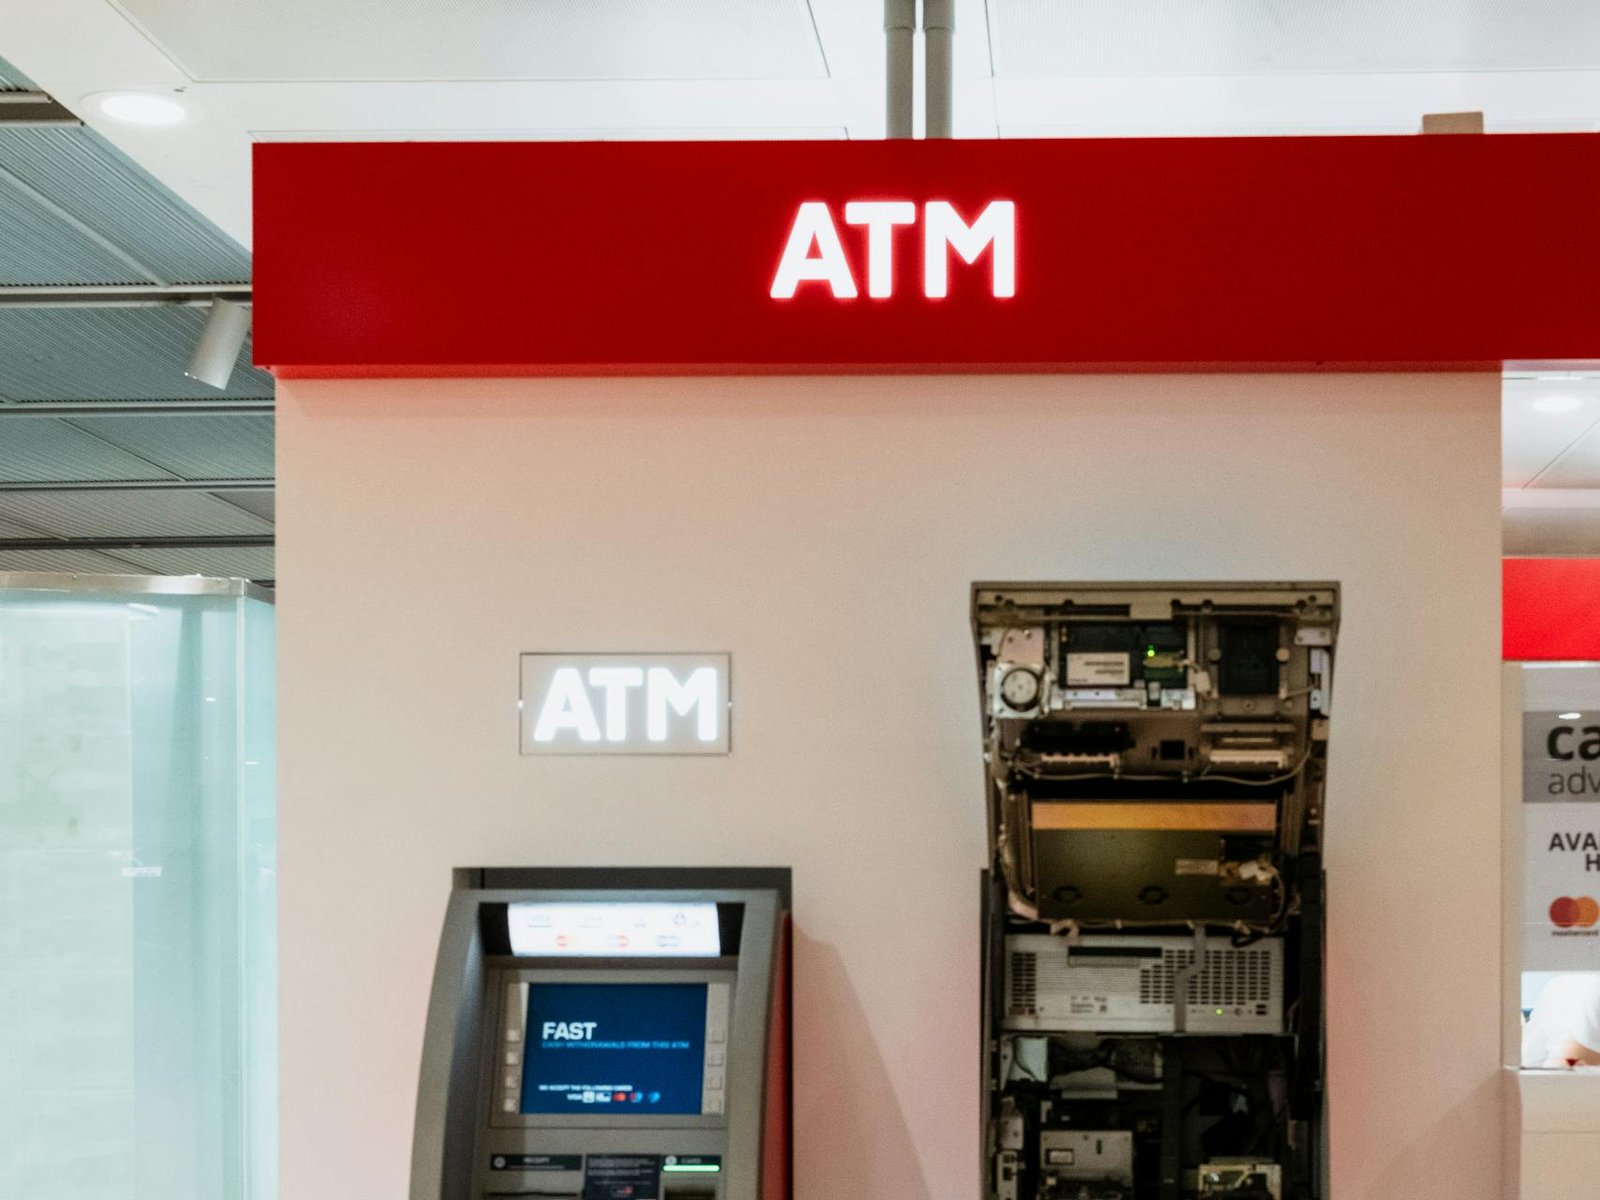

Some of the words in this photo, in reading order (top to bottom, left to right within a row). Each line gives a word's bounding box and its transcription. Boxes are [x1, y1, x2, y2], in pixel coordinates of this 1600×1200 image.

[769, 200, 1016, 299] ATM
[533, 666, 718, 743] ATM
[1546, 725, 1600, 761] ca
[1547, 765, 1600, 795] adv
[1549, 832, 1600, 851] AVA
[1585, 853, 1600, 872] H
[541, 1021, 598, 1040] FAST
